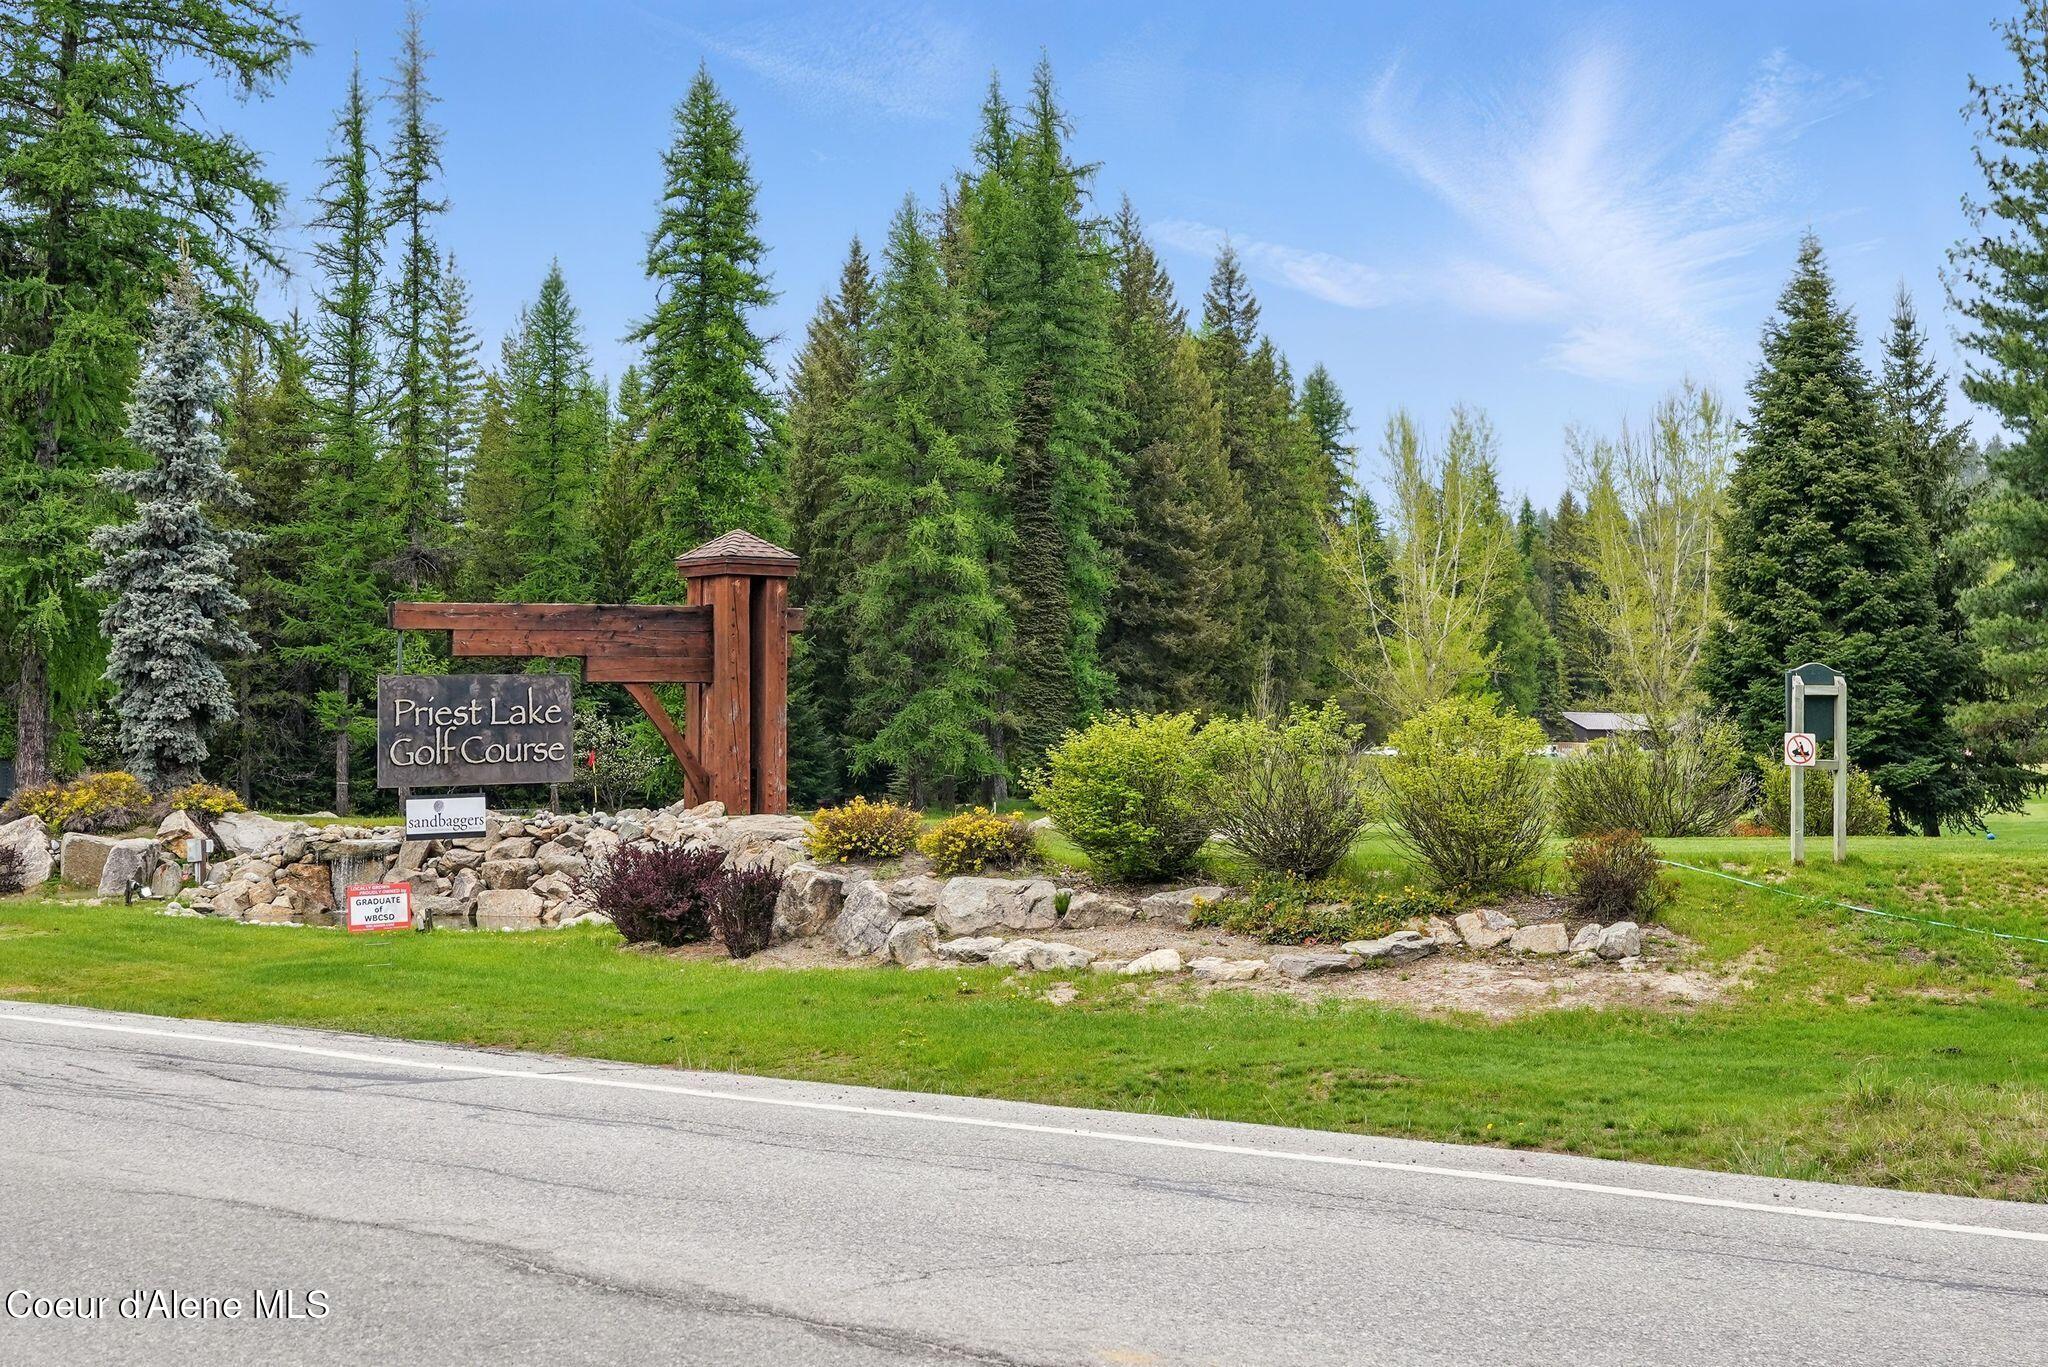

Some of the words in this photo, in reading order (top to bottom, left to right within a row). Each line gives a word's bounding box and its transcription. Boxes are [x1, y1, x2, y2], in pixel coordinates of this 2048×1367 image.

[393, 696, 482, 727] Priest
[490, 686, 562, 725] Lake
[389, 726, 457, 766] Golf
[460, 736, 566, 764] Course
[408, 812, 485, 831] sandbaggers
[355, 896, 401, 906] GRADUATE
[374, 905, 383, 913] of
